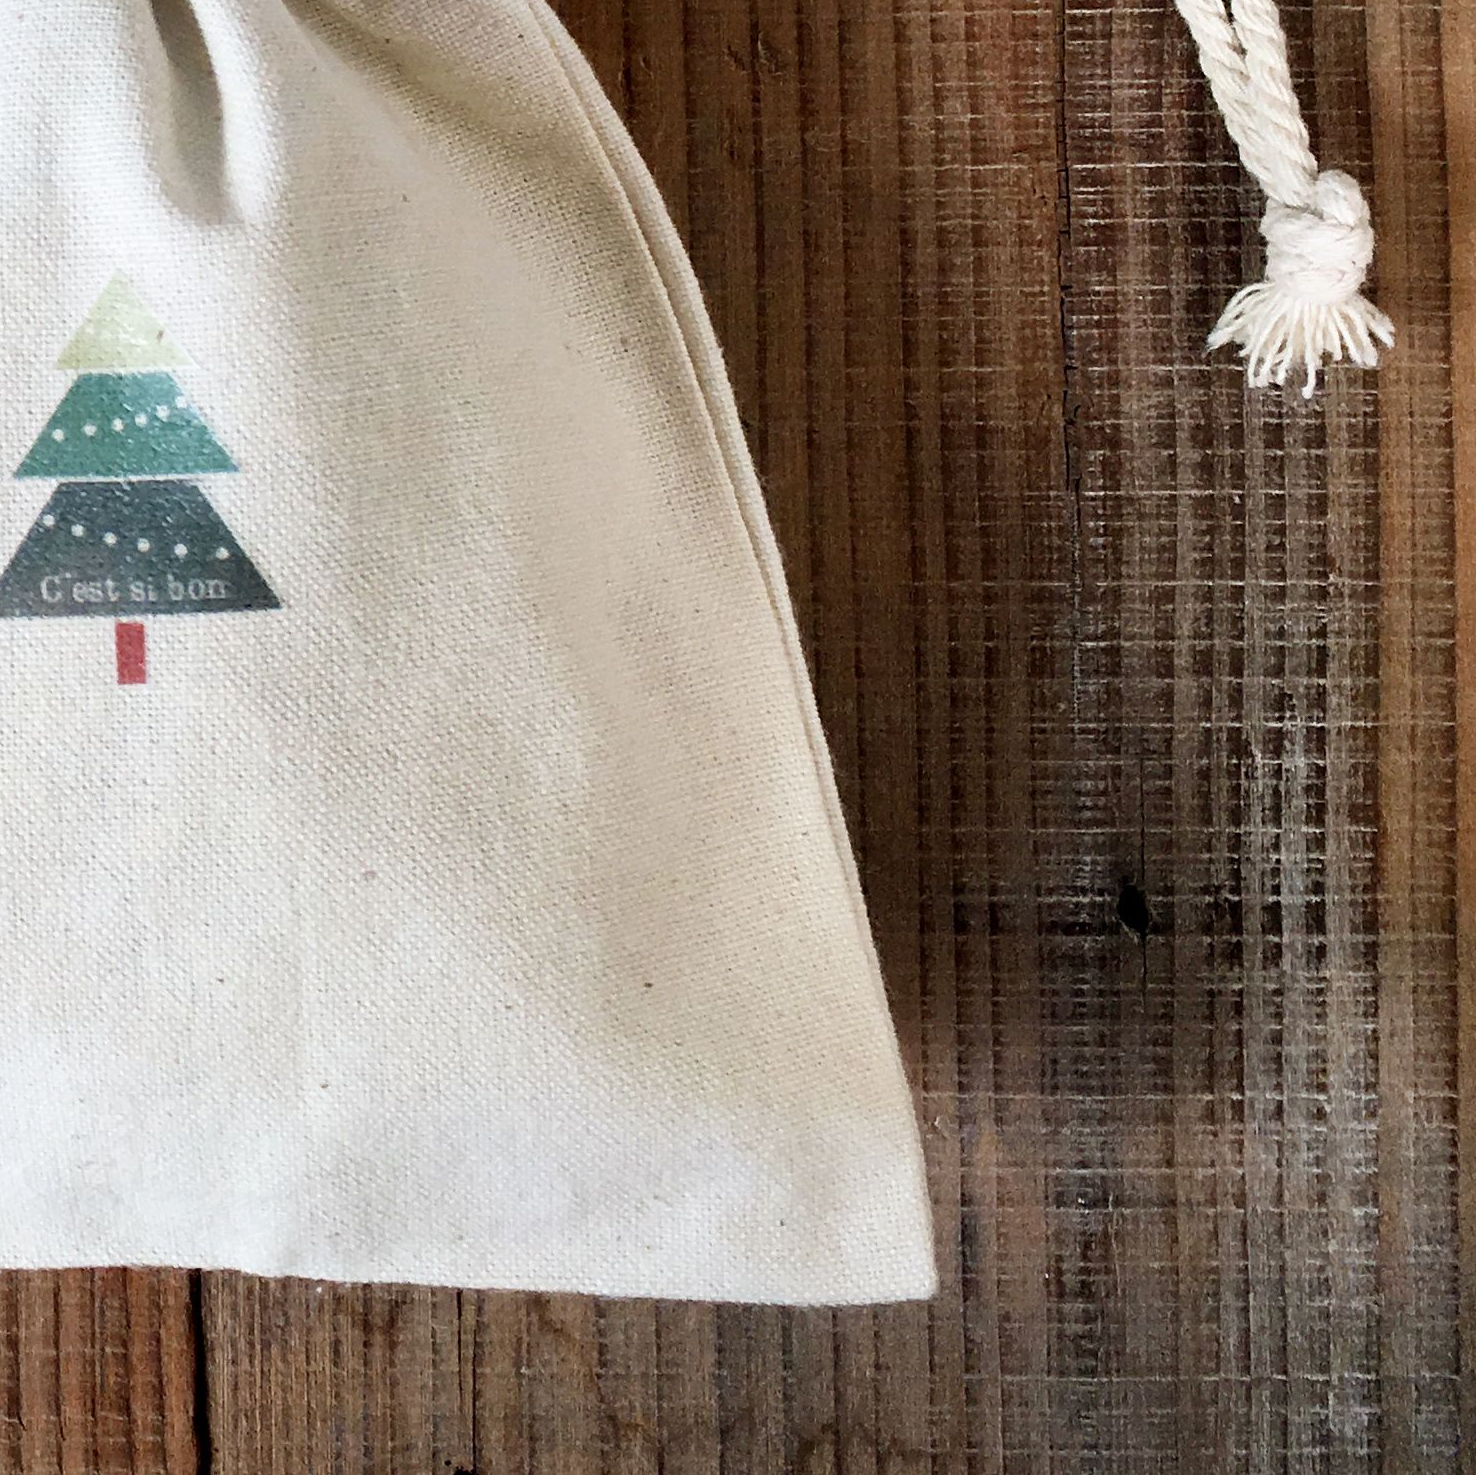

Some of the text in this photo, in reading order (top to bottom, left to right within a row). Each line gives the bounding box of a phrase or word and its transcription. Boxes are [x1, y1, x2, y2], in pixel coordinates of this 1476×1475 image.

[39, 572, 228, 604] C'est si bon
